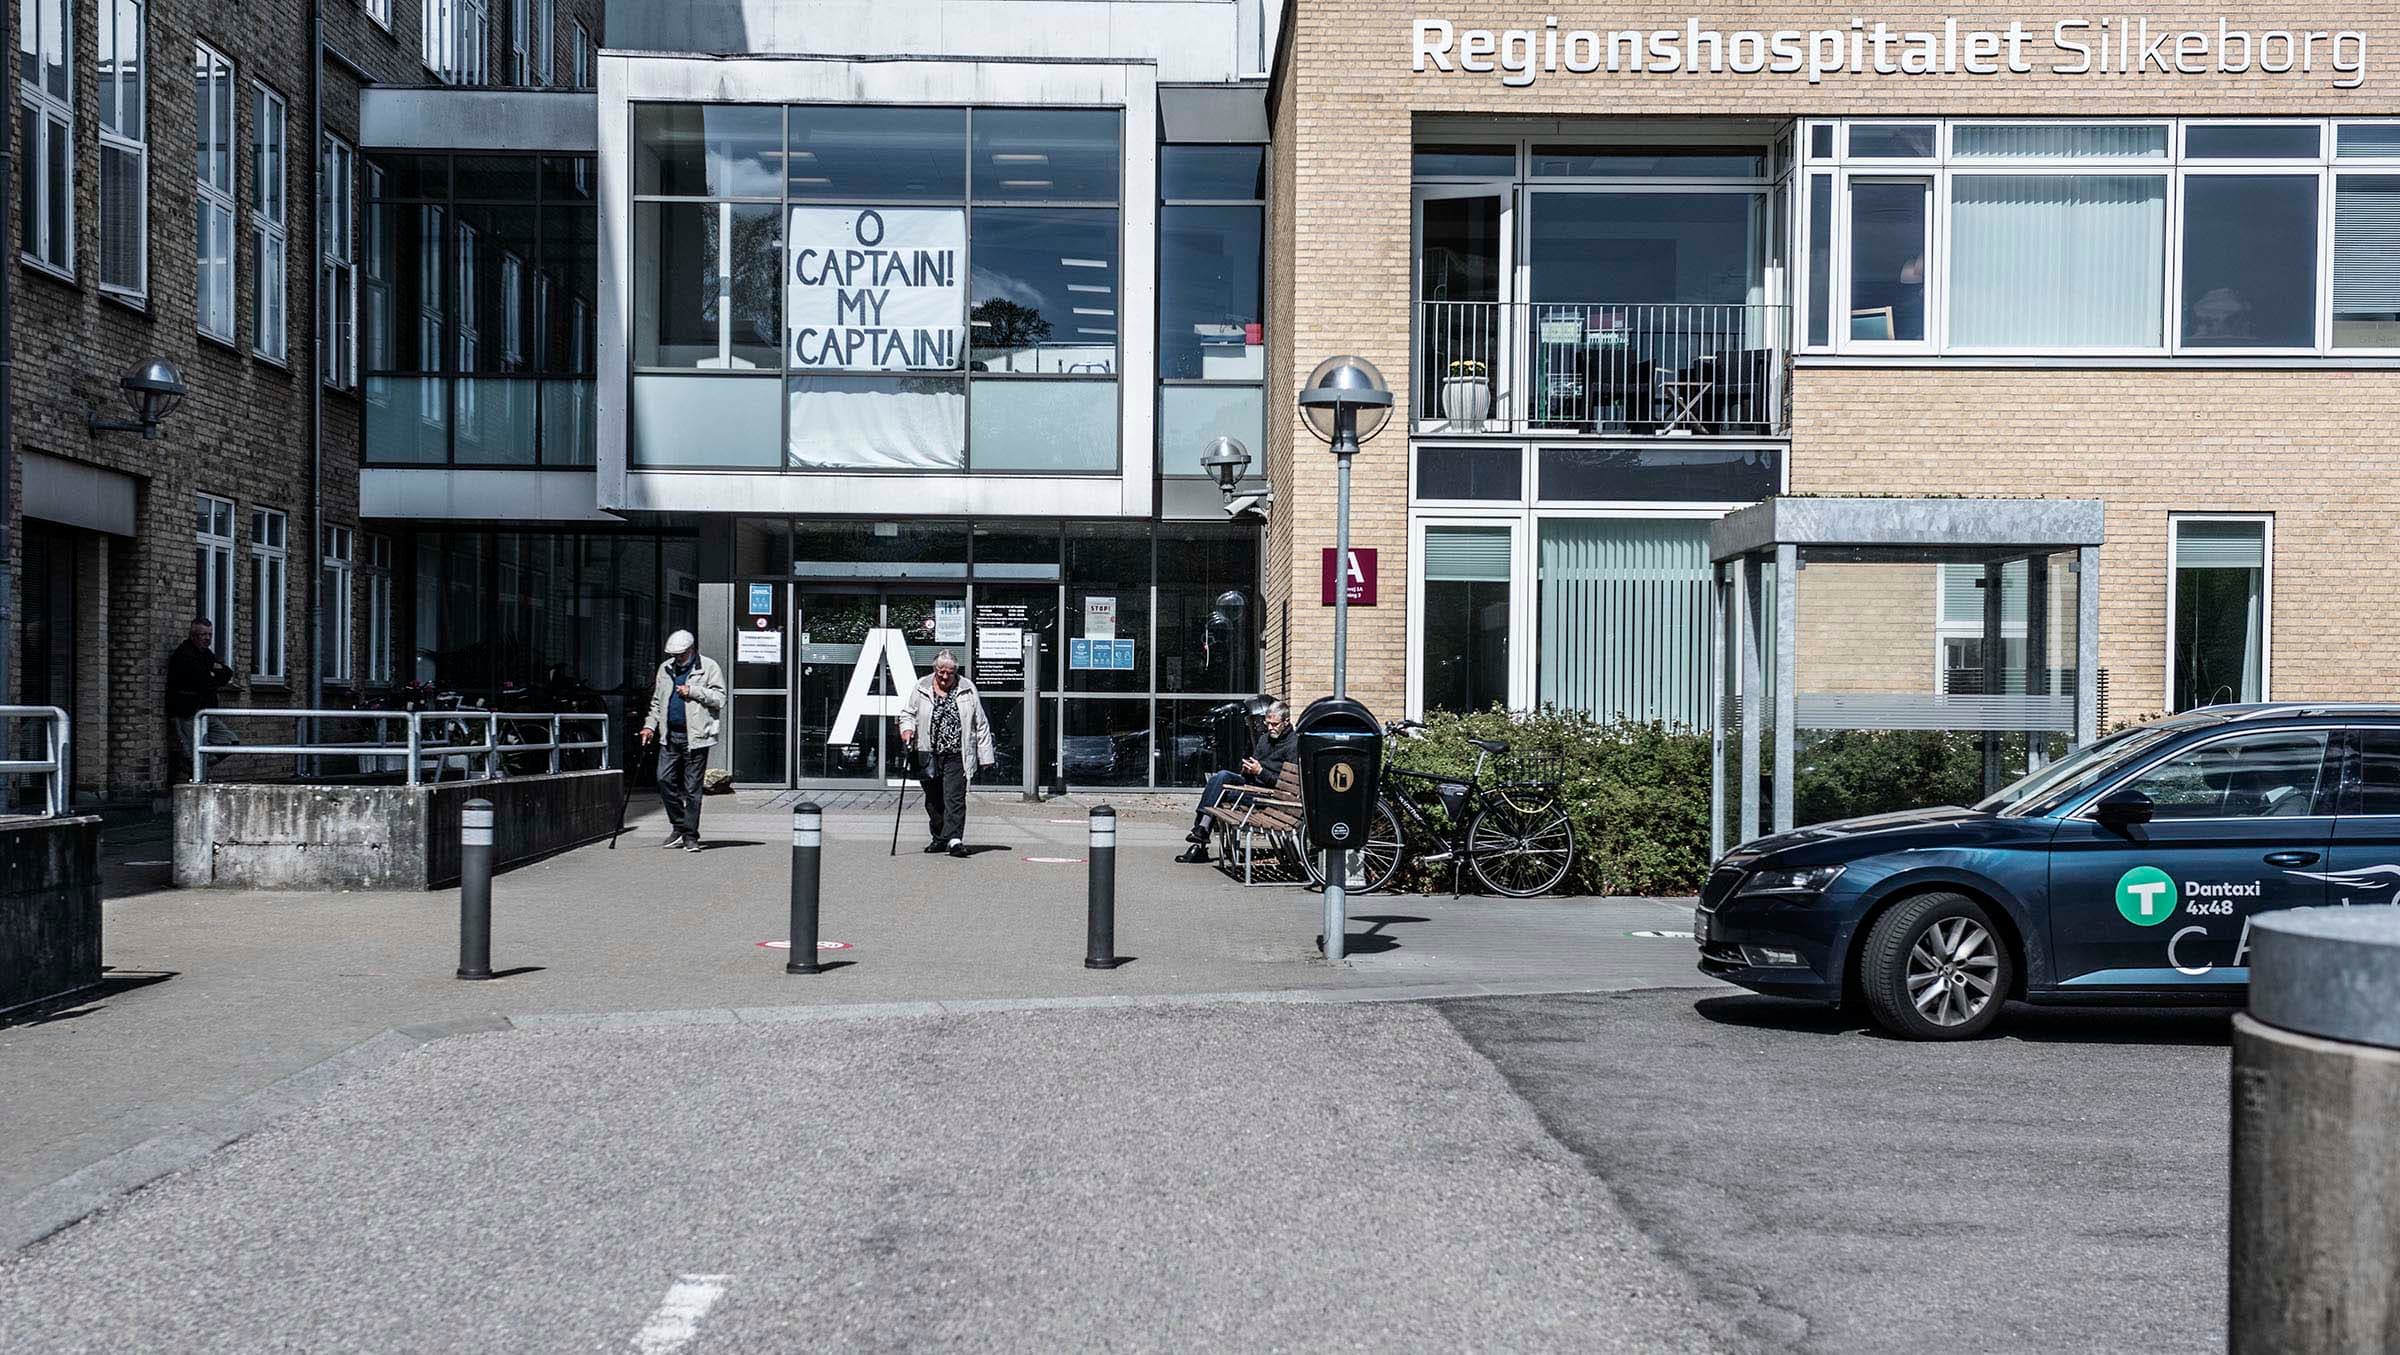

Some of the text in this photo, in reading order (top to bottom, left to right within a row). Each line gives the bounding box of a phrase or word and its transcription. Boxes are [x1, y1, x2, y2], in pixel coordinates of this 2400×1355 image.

[1412, 16, 2367, 88] Regionshospitalet Silkeborg
[855, 209, 884, 247] O
[796, 249, 954, 287] CAPTAIN!
[837, 288, 890, 326] MY
[796, 327, 954, 366] CAPTAIN!
[1334, 551, 1365, 583] A
[827, 628, 919, 744] A
[2185, 880, 2261, 897] Dantaxi
[2185, 900, 2234, 916] 4x48
